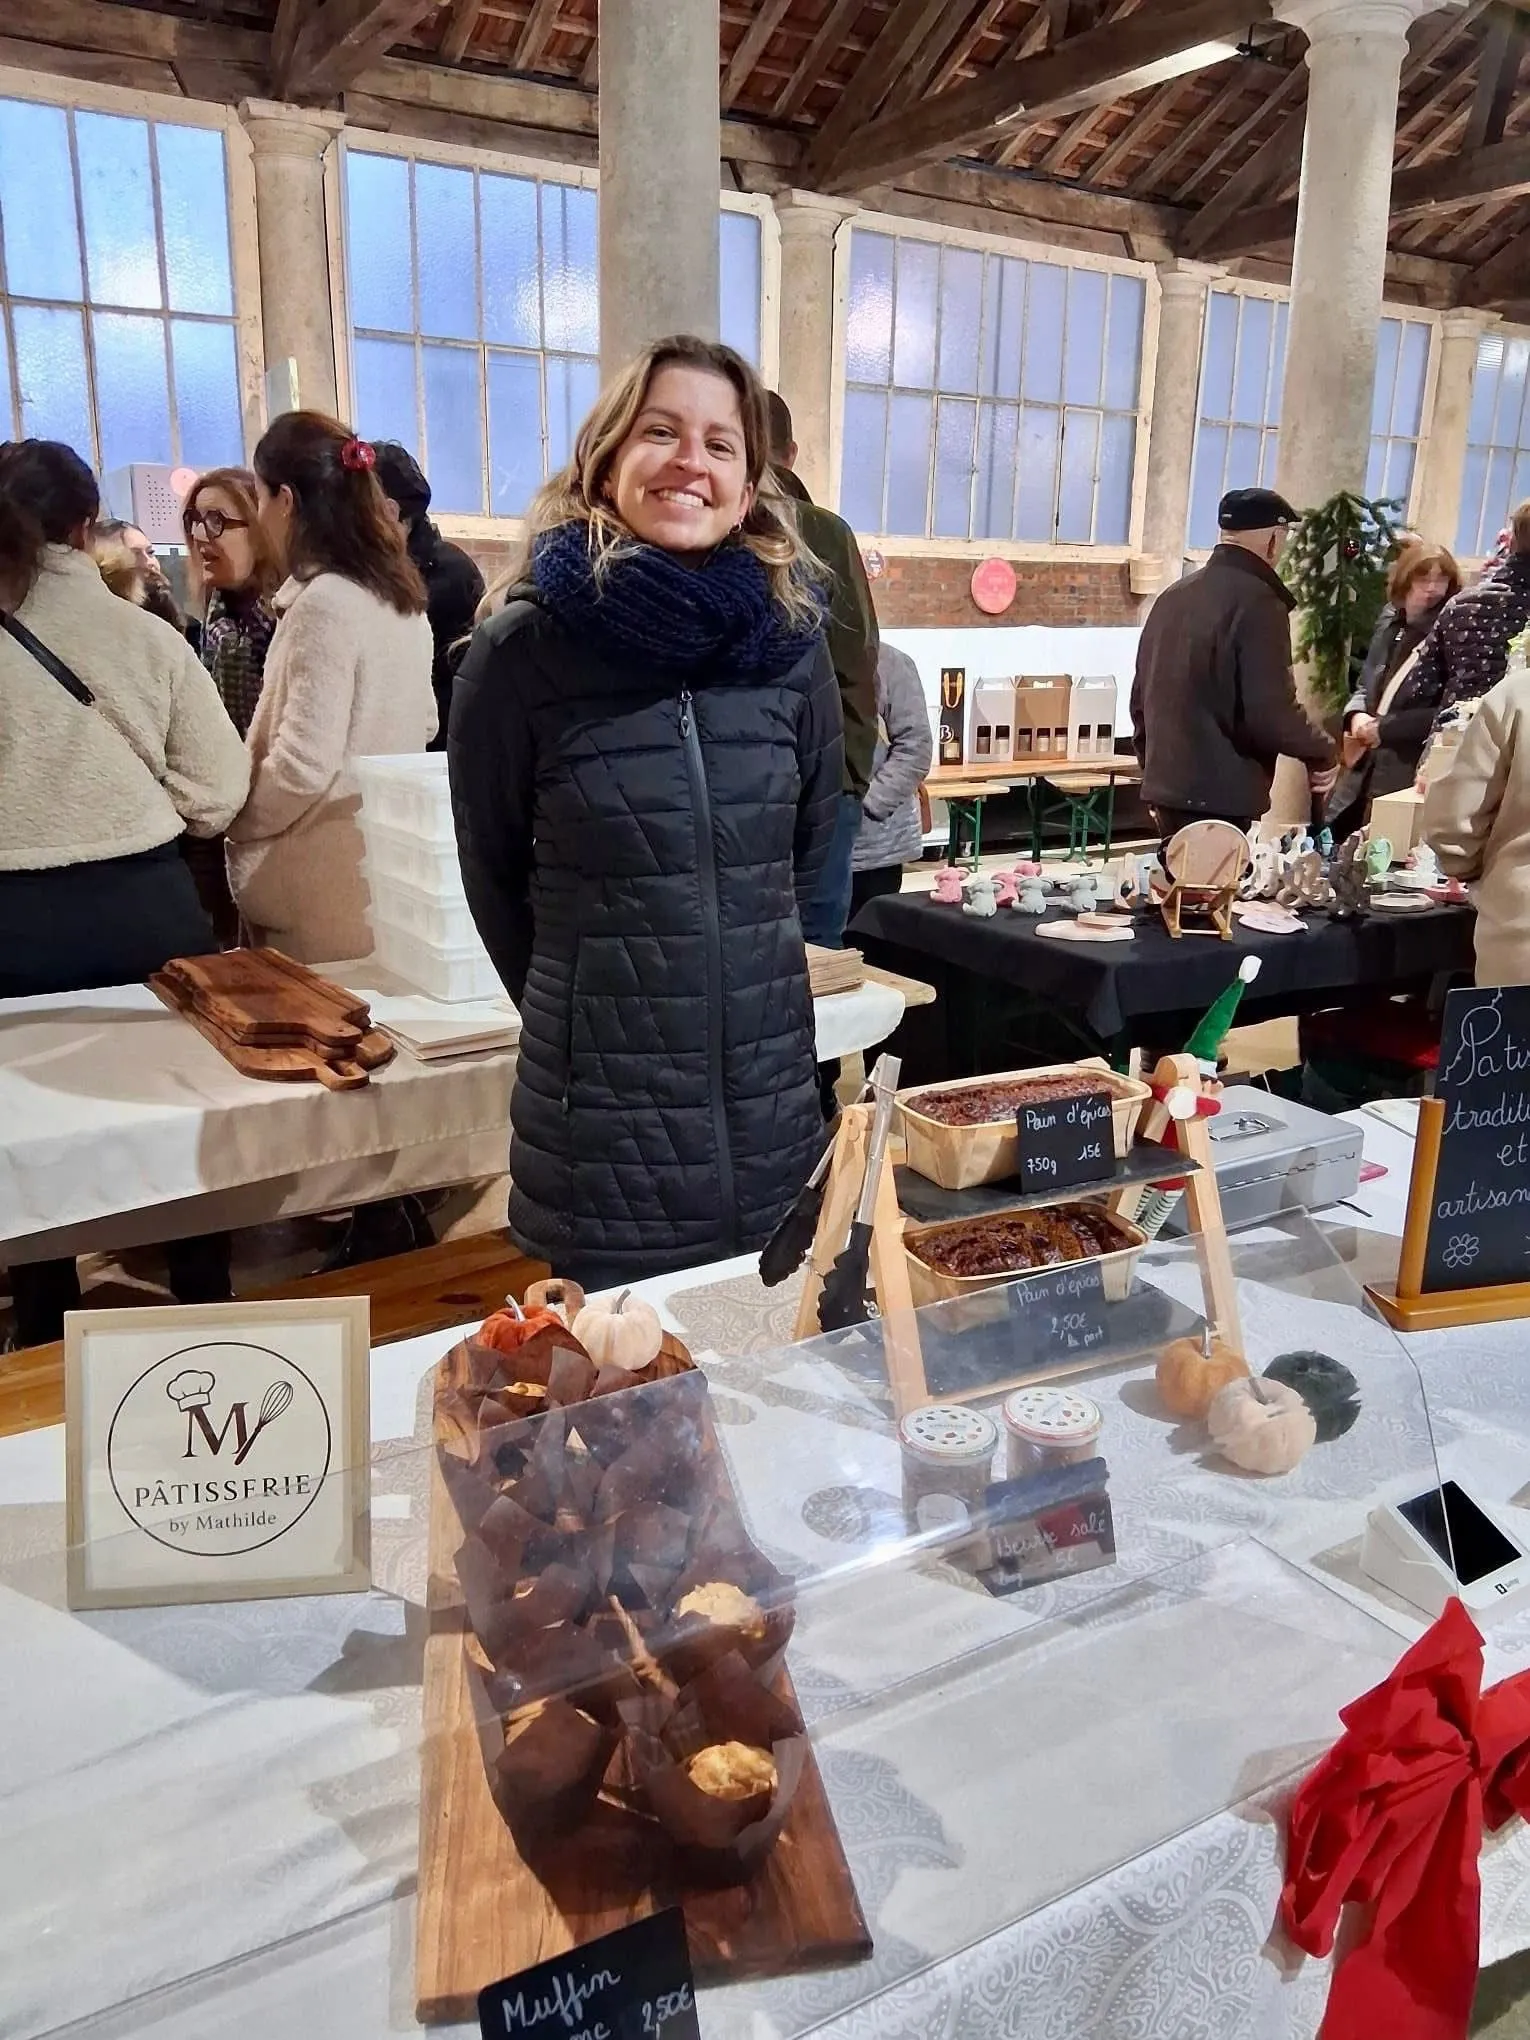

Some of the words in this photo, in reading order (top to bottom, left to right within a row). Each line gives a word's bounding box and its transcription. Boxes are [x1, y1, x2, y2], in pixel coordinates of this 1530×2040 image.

[1026, 1110, 1056, 1131] Pain
[1027, 1156, 1057, 1176] 750g
[1077, 1142, 1101, 1161] 15€
[1497, 1133, 1528, 1166] et
[1016, 1281, 1049, 1307] Pain
[1051, 1312, 1087, 1341] 2,50€
[1084, 1325, 1104, 1347] part
[181, 1401, 250, 1459] M
[135, 1474, 312, 1508] PÂTISSERIE
[169, 1518, 190, 1536] by
[196, 1510, 277, 1531] Mathilde
[502, 1970, 621, 2032] Muffin
[641, 1982, 693, 2040] 2,50€
